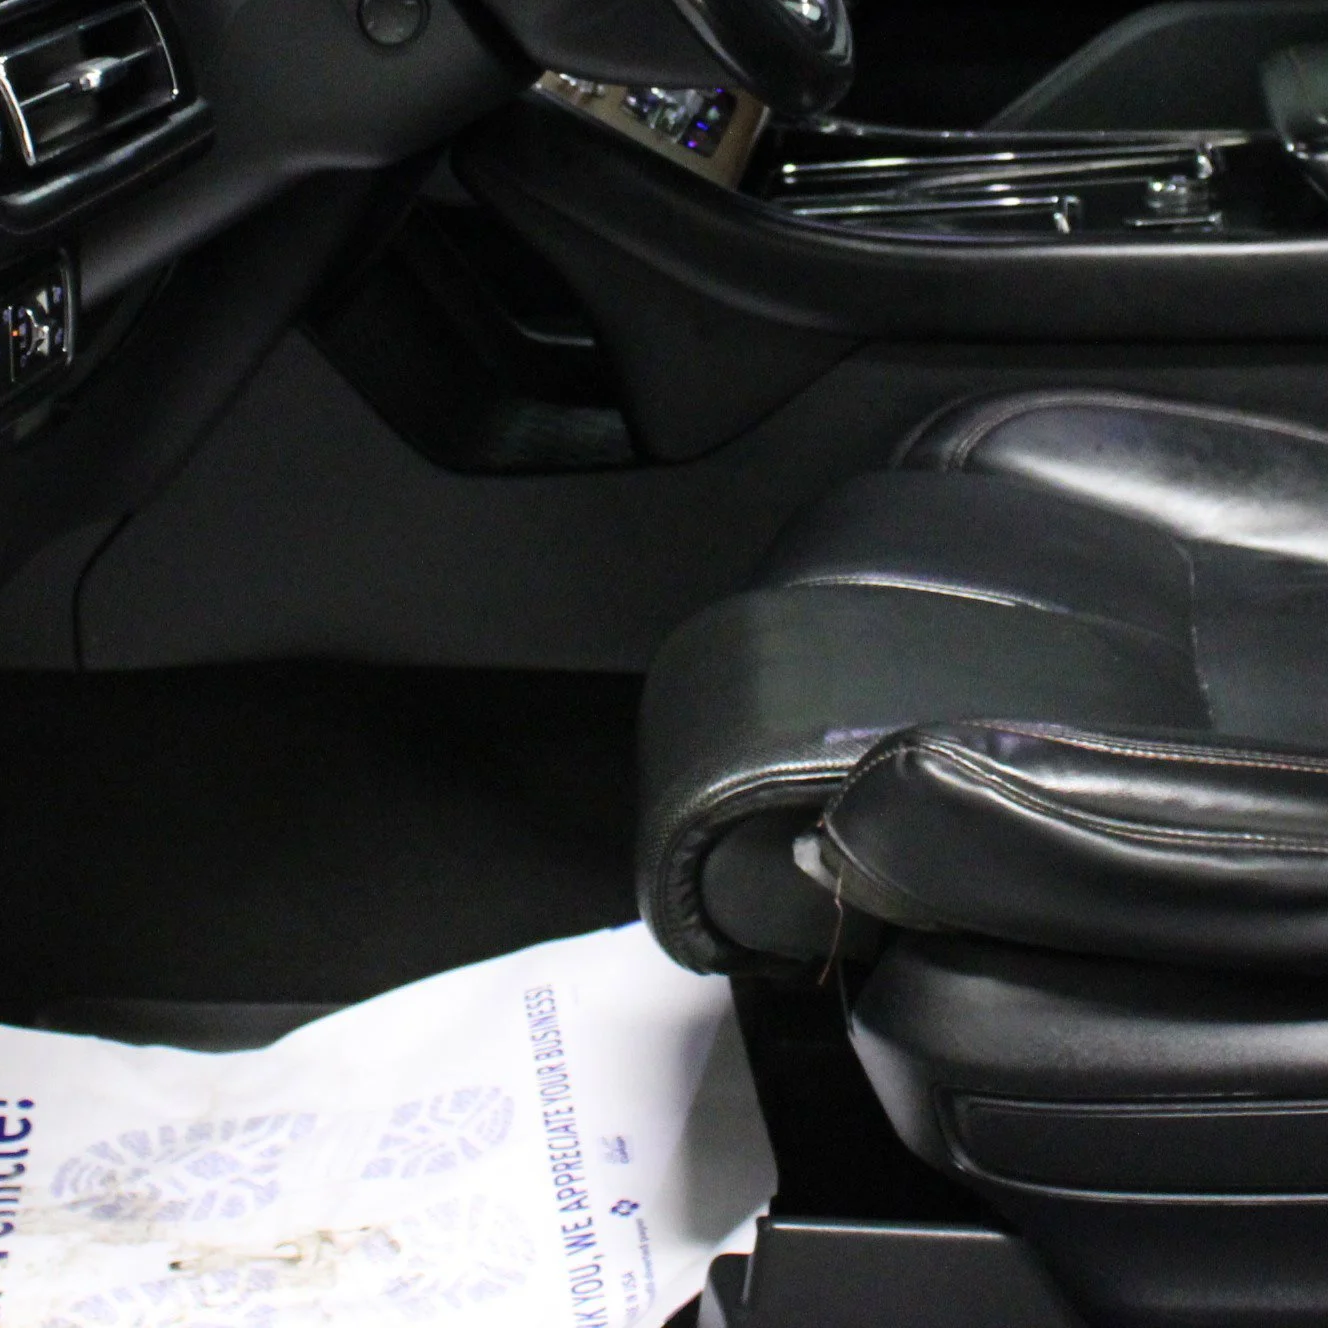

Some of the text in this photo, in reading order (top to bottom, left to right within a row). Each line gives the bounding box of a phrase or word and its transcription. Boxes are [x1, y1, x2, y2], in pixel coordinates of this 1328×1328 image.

[524, 984, 565, 1062] BUSINESS!
[536, 1062, 573, 1107] YOUR
[543, 1106, 591, 1213] APPRECIATE
[561, 1216, 597, 1257] WE
[568, 1254, 606, 1307] YOU,
